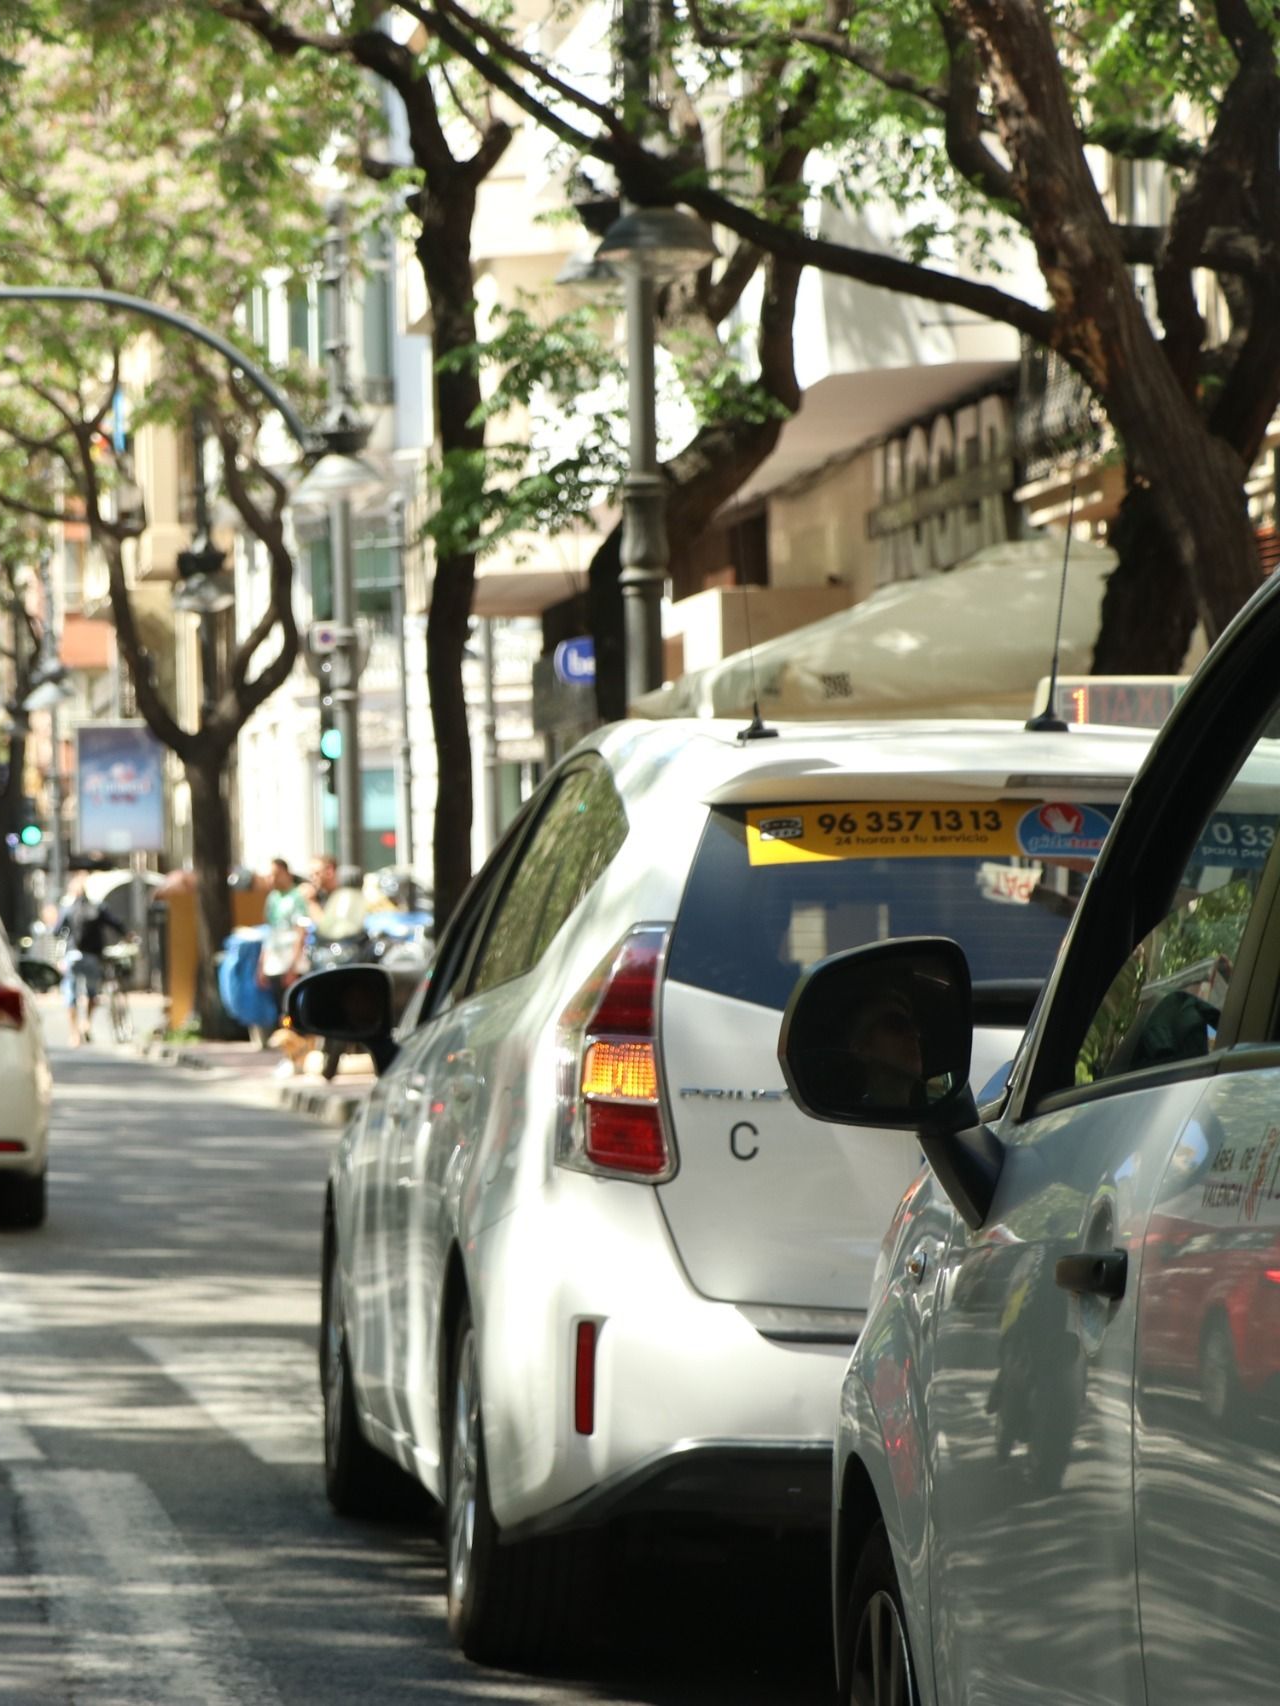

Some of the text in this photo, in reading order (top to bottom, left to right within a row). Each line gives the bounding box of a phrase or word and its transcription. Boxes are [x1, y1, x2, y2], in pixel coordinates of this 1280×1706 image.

[1094, 687, 1170, 724] TAXI
[817, 813, 858, 834] 96
[866, 810, 923, 833] 357
[929, 810, 964, 832] 13
[970, 809, 1003, 832] 13
[835, 835, 852, 846] 24
[855, 832, 896, 845] horas
[900, 834, 911, 844] a
[932, 832, 989, 844] servicio
[1201, 846, 1238, 857] para
[728, 1120, 760, 1162] C
